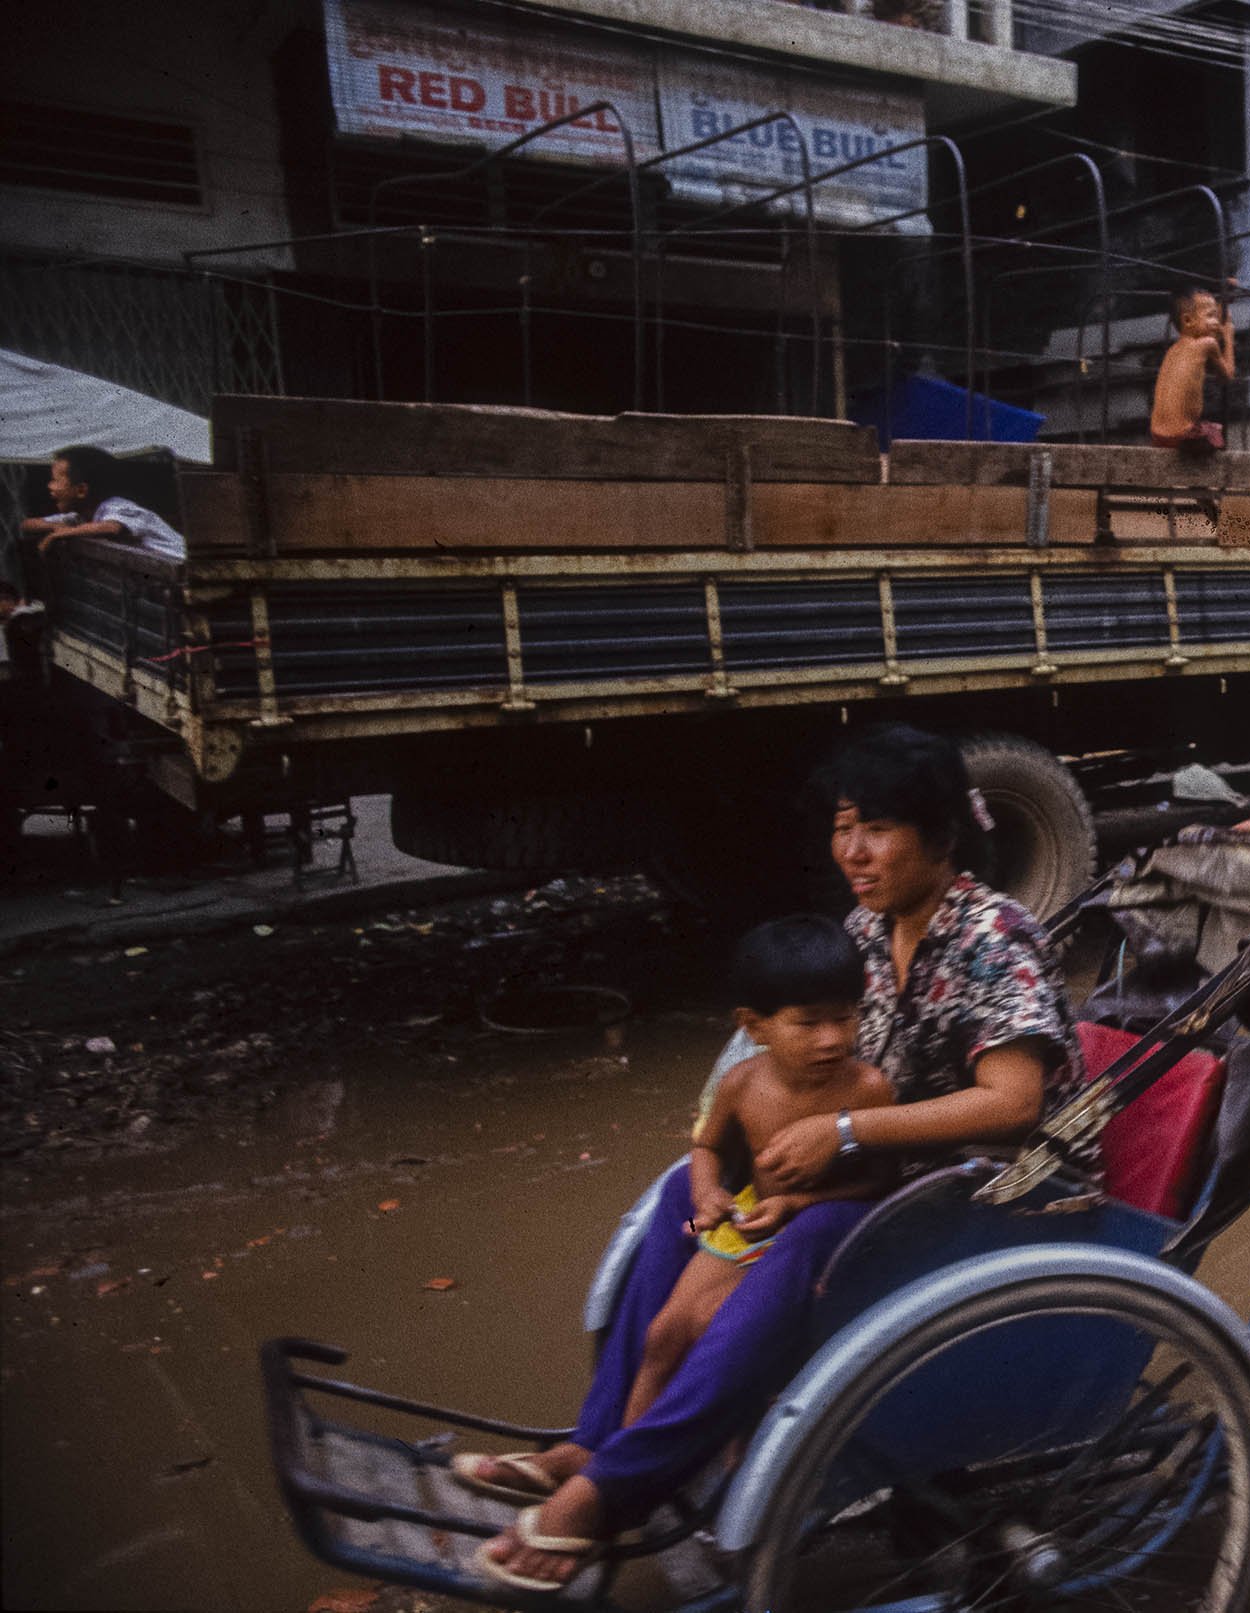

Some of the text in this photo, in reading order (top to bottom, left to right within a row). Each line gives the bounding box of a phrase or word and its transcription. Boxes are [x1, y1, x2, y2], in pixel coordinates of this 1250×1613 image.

[378, 64, 486, 113] RED
[504, 85, 620, 132] BULL
[692, 110, 907, 169] BLUE BULL
